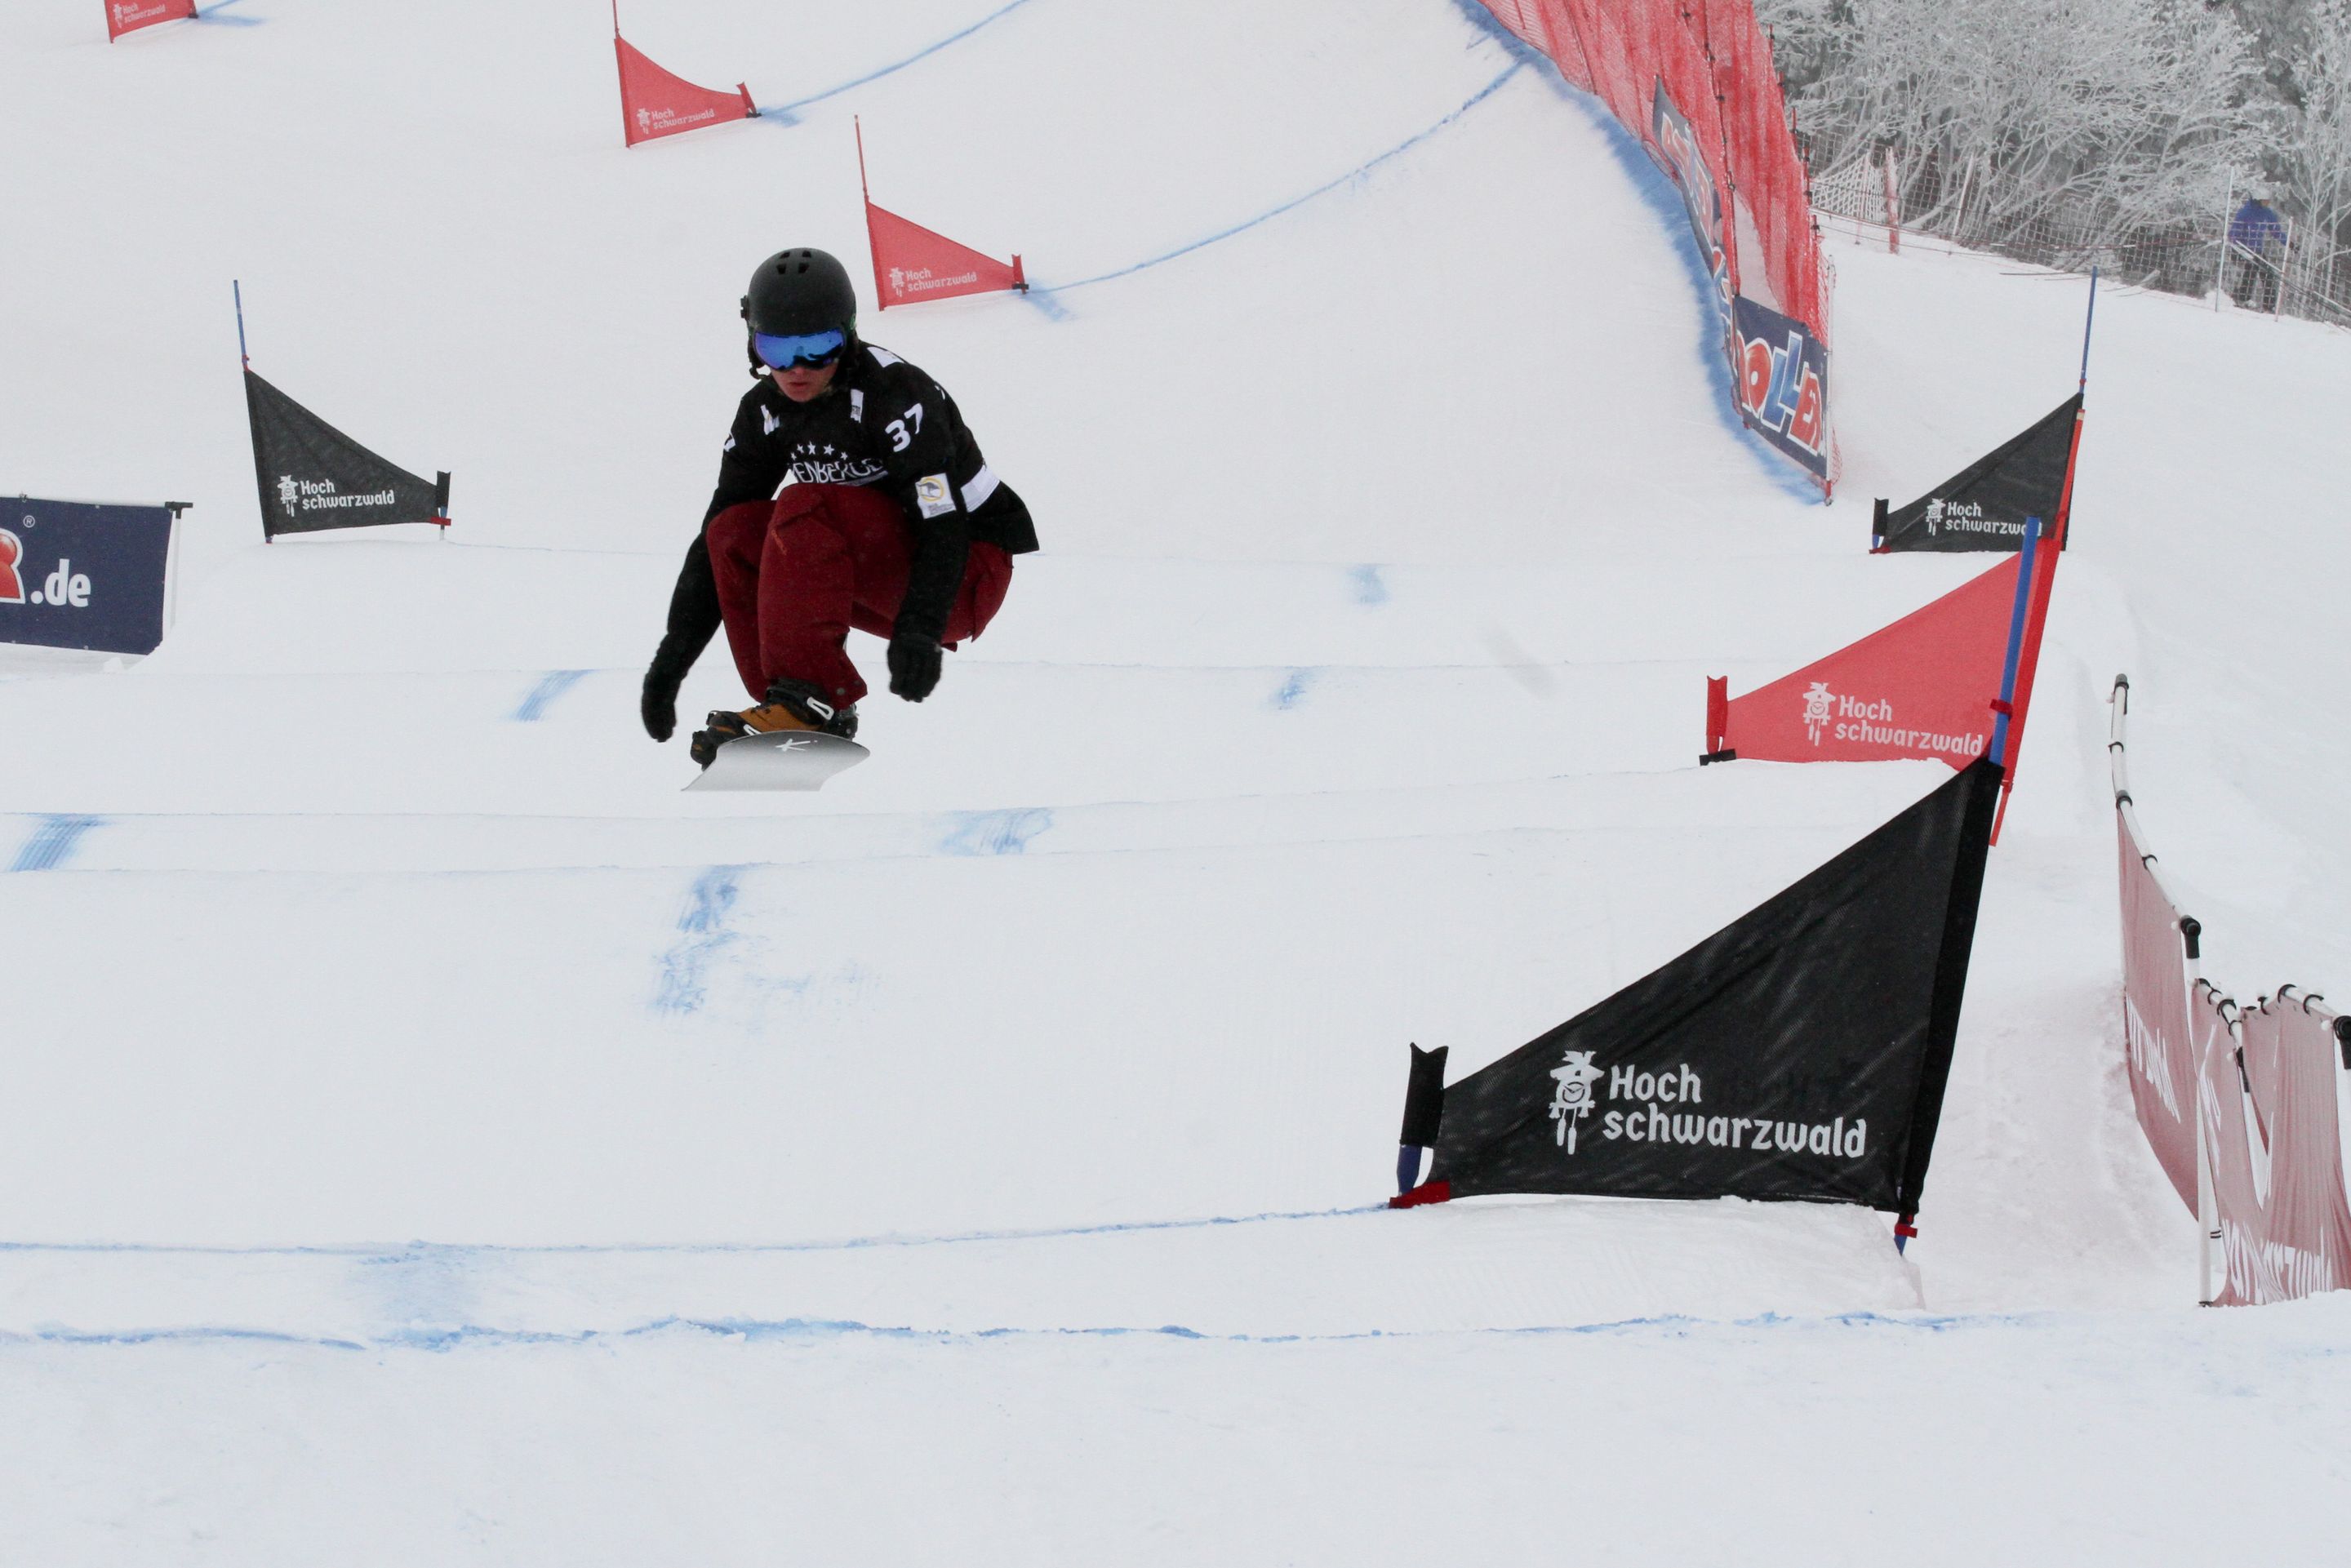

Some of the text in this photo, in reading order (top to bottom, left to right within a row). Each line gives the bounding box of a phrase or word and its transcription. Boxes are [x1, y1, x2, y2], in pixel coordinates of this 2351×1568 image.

[652, 109, 674, 120] Hoch
[653, 109, 715, 129] schwarzwald
[906, 268, 931, 282] Hoch
[908, 272, 976, 291] schwarzwald
[884, 403, 922, 452] 37
[301, 479, 336, 495] Hoch
[303, 491, 394, 510] schwarzwald
[1948, 501, 1981, 517] Hoch
[1945, 517, 2042, 535] schwarzwa
[1840, 695, 1891, 721] Hoch
[1836, 720, 1983, 755] schwarzwald
[1609, 1064, 1701, 1103] Hoch
[1602, 1104, 1867, 1159] schwarzwald
